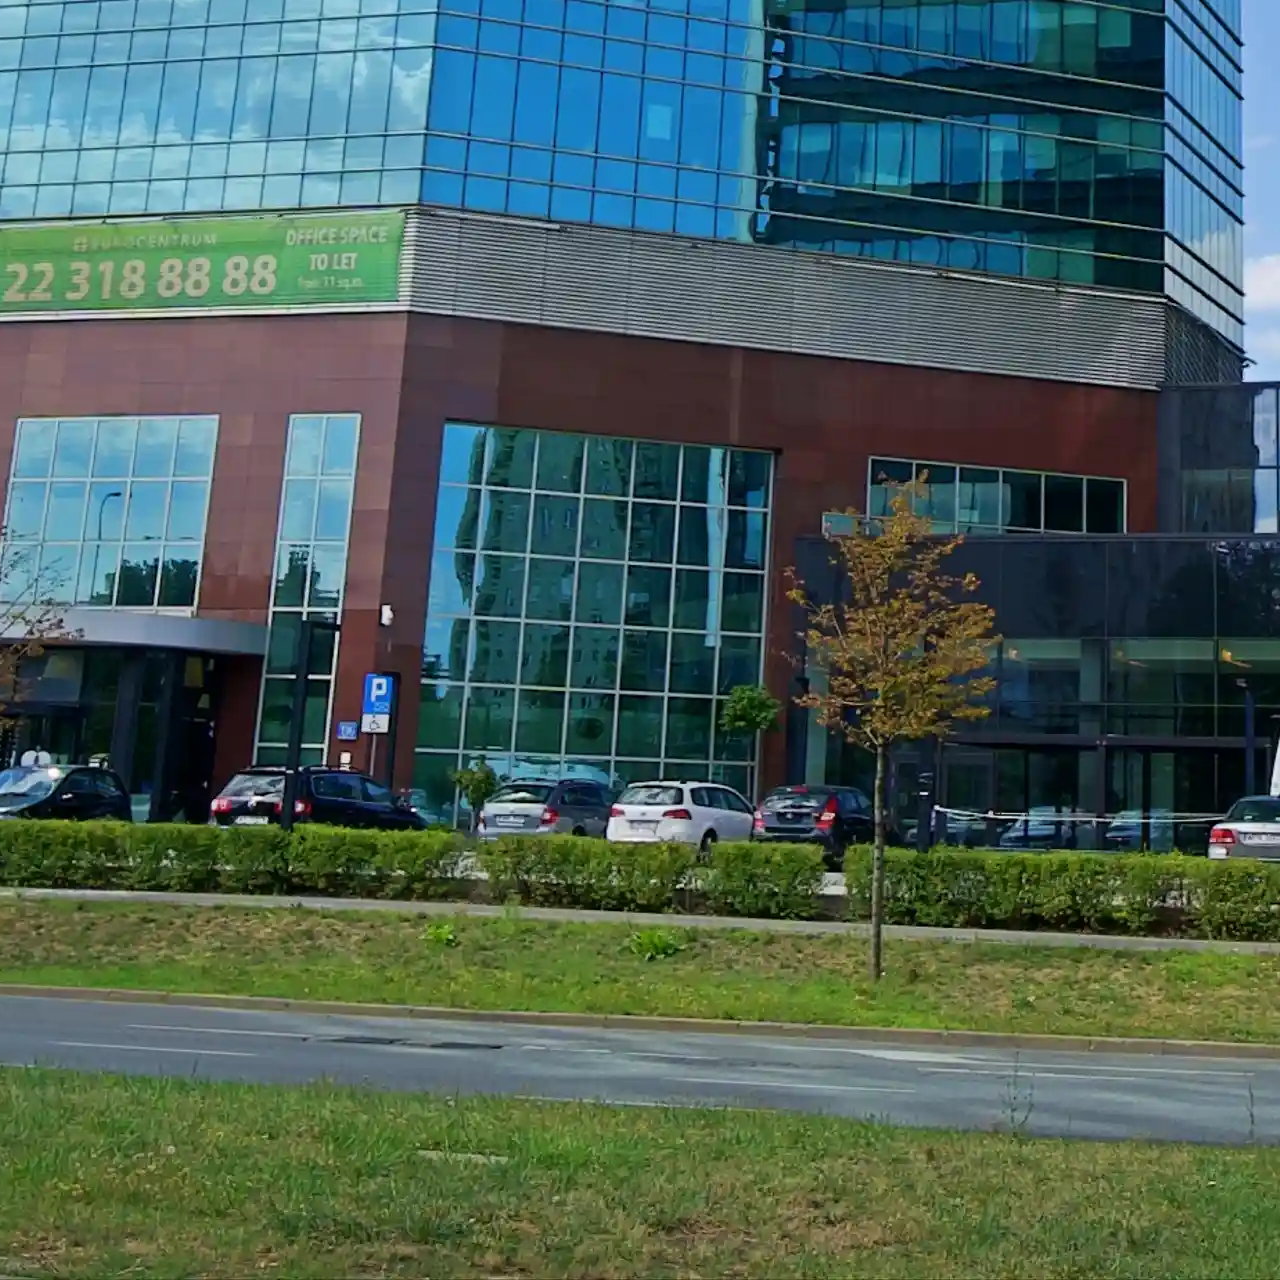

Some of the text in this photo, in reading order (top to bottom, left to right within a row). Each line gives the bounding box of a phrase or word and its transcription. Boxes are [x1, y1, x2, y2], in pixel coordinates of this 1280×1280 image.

[286, 225, 389, 246] OFFICE SPACE
[309, 252, 358, 271] TO LET
[3, 262, 55, 302] 22
[65, 259, 146, 300] 318
[157, 257, 211, 298] 88
[222, 254, 277, 295] 88
[370, 678, 388, 702] P
